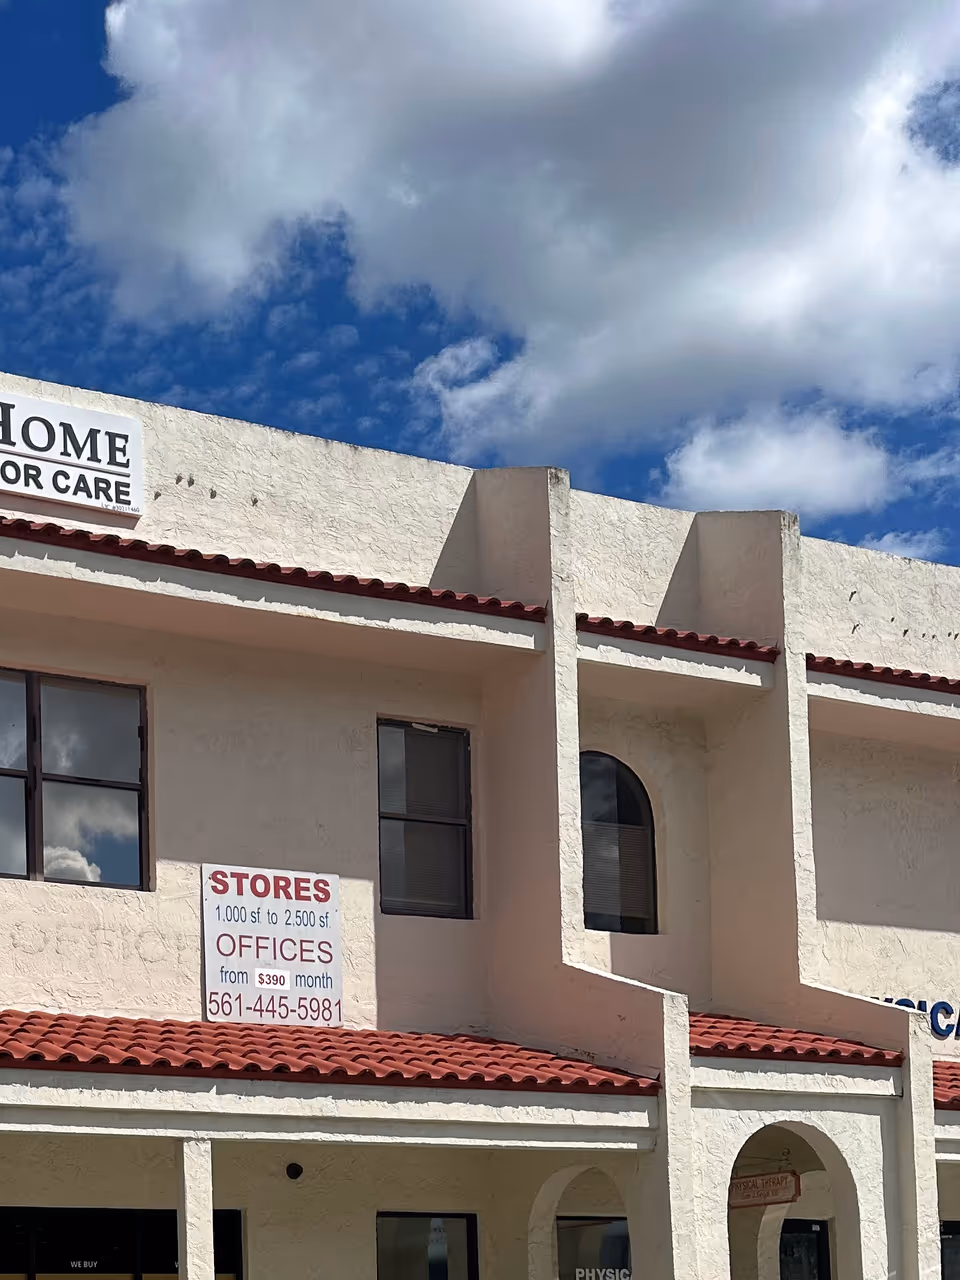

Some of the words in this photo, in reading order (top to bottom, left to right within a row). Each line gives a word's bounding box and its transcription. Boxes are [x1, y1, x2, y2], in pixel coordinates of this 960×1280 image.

[52, 469, 132, 506] CARE
[211, 870, 331, 903] STORES
[267, 909, 278, 925] to
[216, 933, 333, 964] OFFICES
[220, 966, 249, 984] from
[258, 973, 286, 986] $390
[295, 972, 333, 989] month
[209, 991, 342, 1022] 561-445-5981
